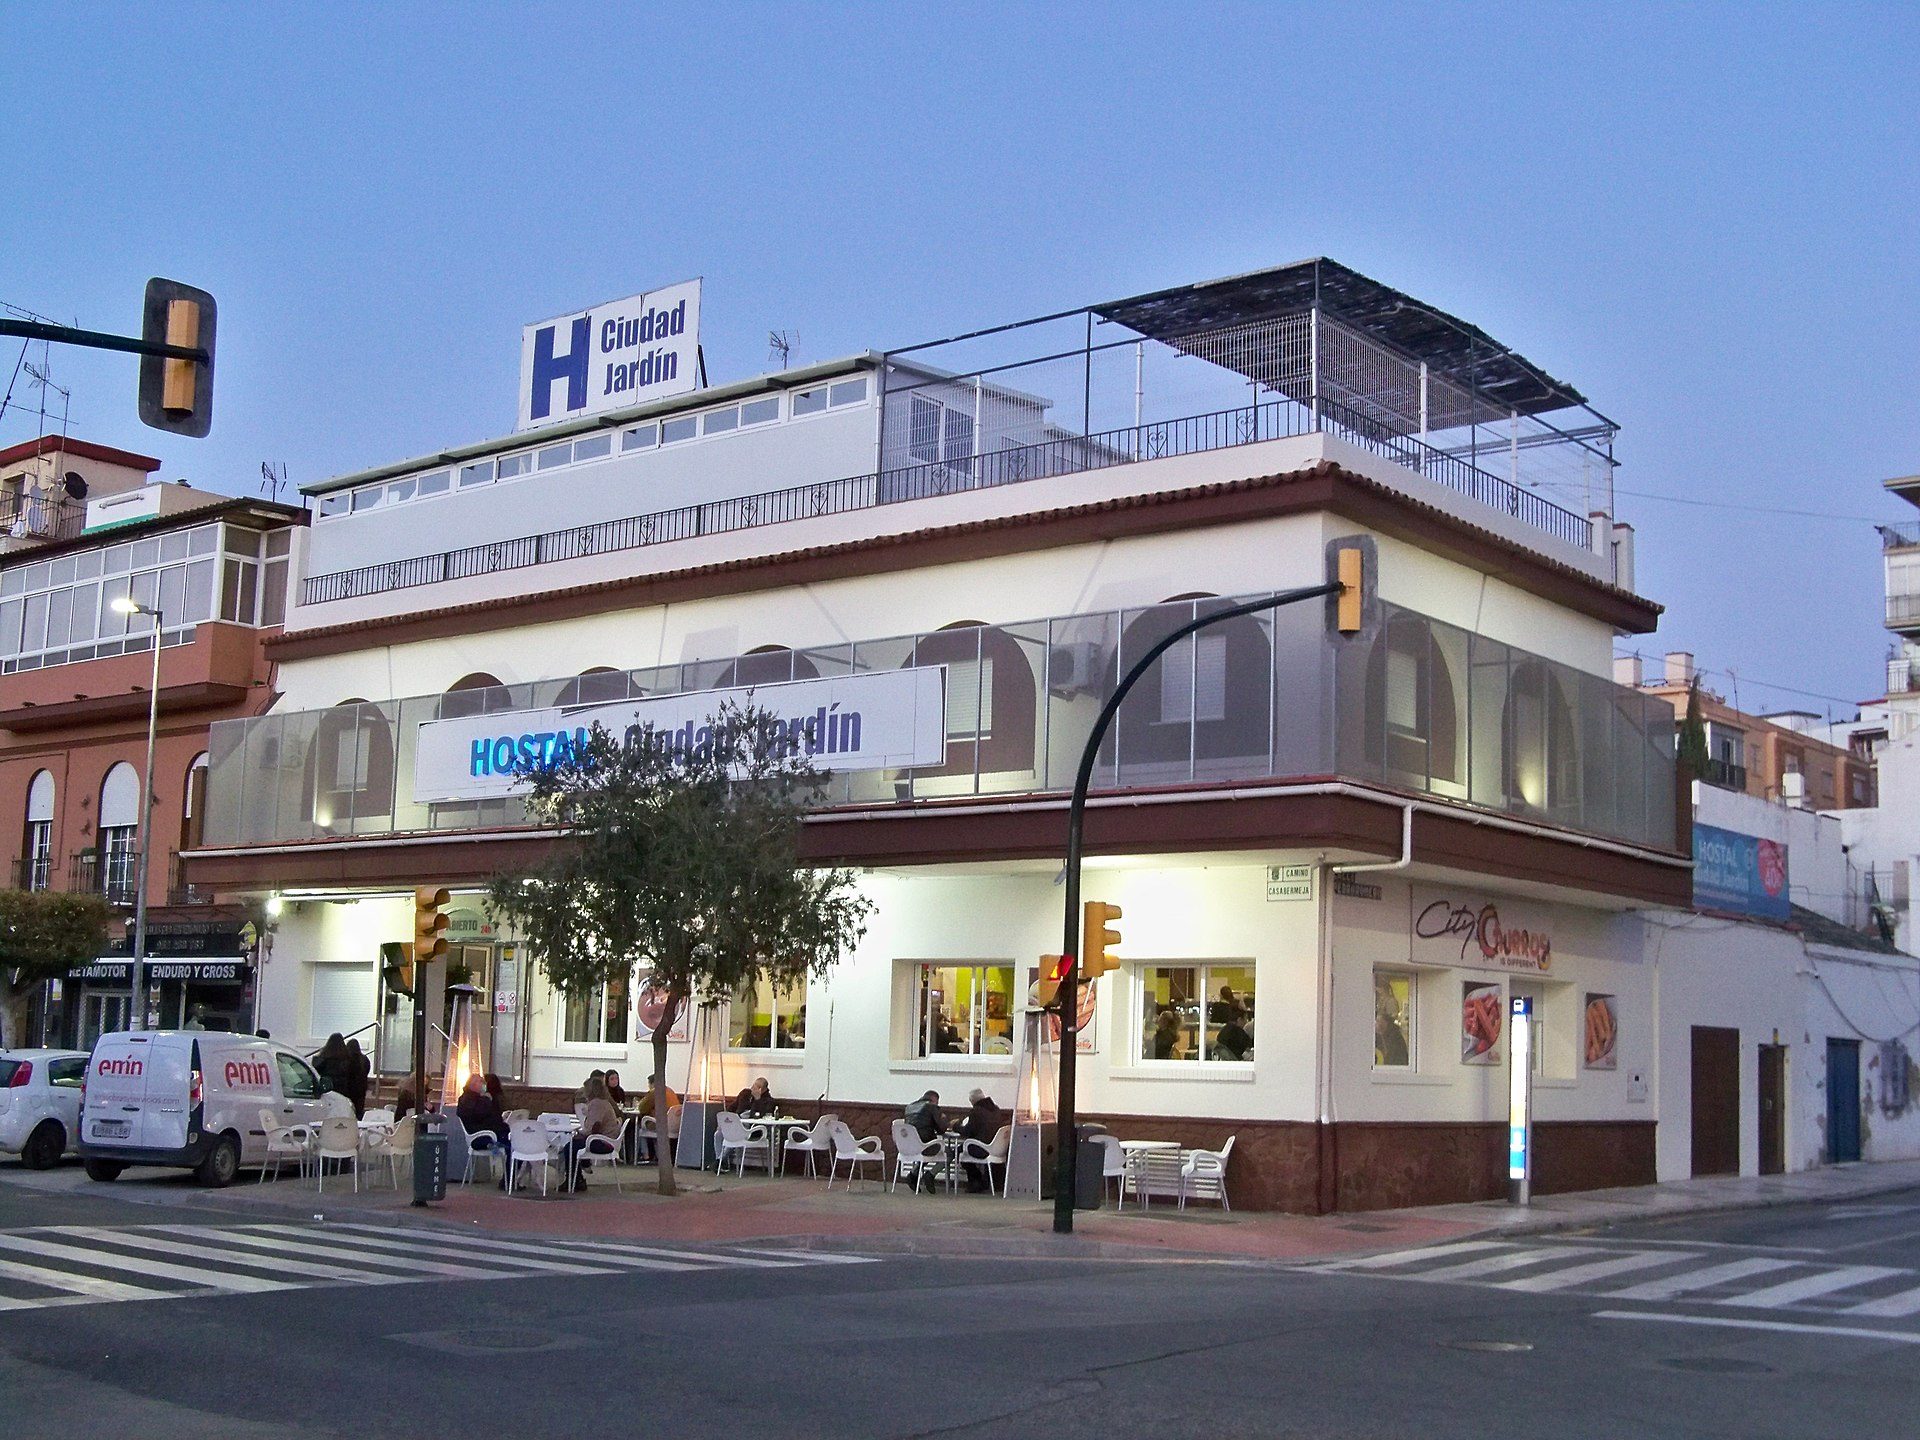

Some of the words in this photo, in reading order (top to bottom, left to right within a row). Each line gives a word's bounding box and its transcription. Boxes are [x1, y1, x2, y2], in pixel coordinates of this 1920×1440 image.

[600, 299, 686, 354] Ciudad
[530, 315, 592, 421] H
[603, 347, 678, 396] Jardín
[1268, 885, 1310, 895] CASABERMEJA
[1286, 868, 1309, 877] CAMINO
[1416, 901, 1475, 960] City
[152, 965, 191, 978] ENDURO
[194, 965, 200, 978] Y
[203, 965, 236, 978] CROSS
